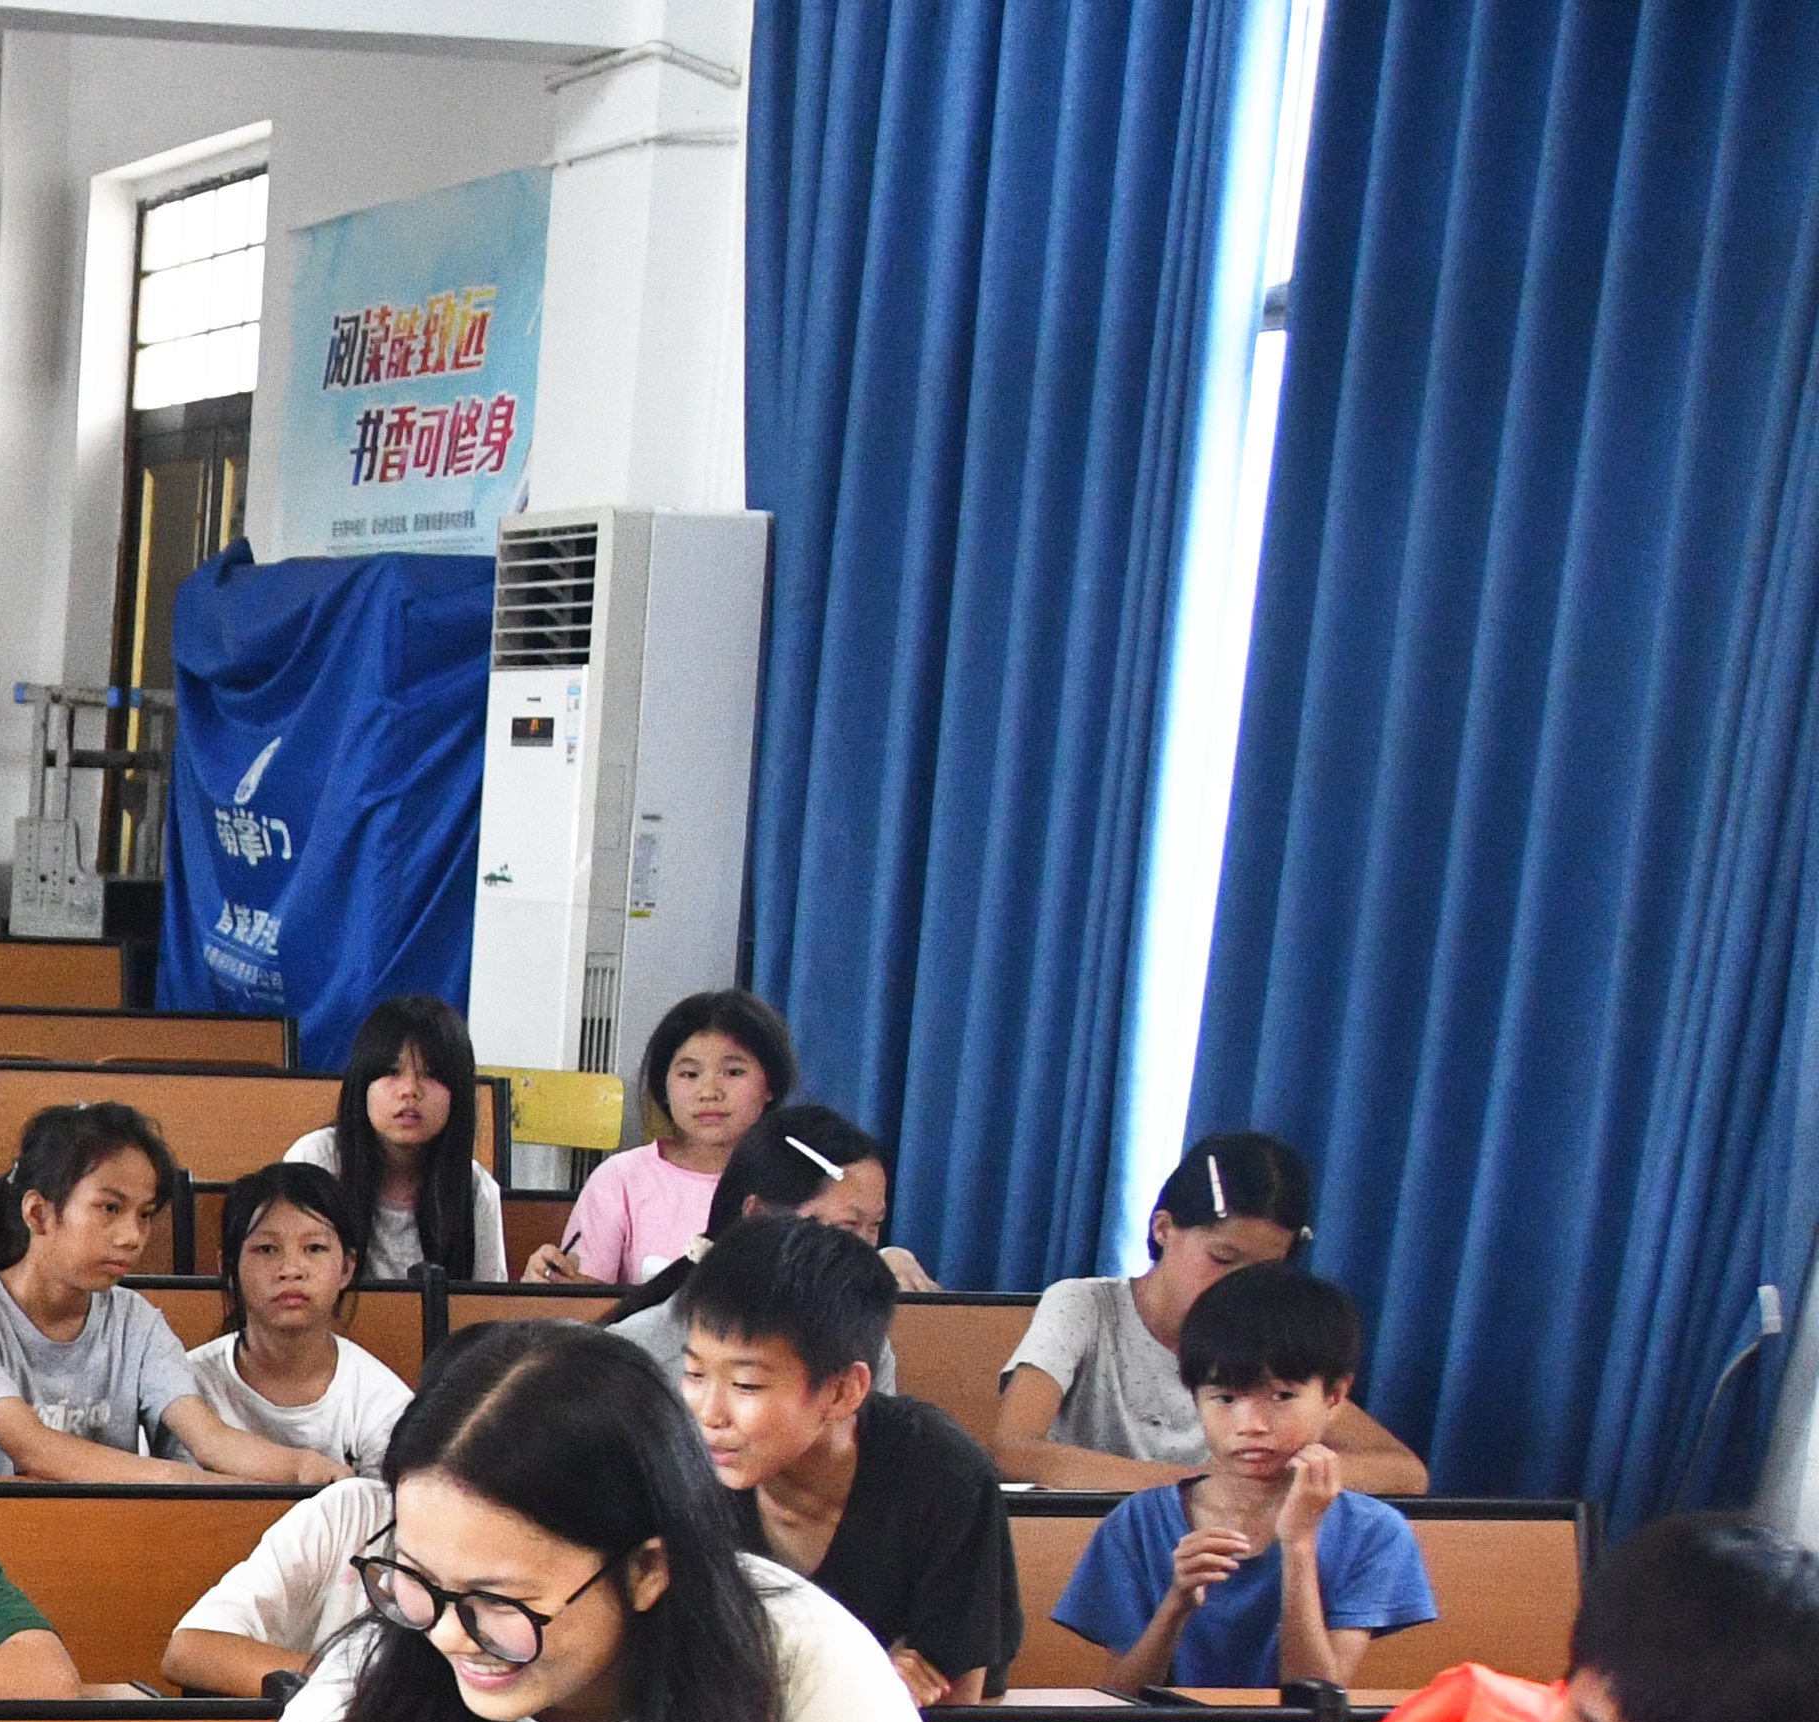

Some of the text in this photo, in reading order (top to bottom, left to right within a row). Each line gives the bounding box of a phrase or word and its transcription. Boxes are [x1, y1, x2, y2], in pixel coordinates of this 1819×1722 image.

[323, 287, 496, 390] 阅读能致远
[350, 393, 516, 486] 书香可修身
